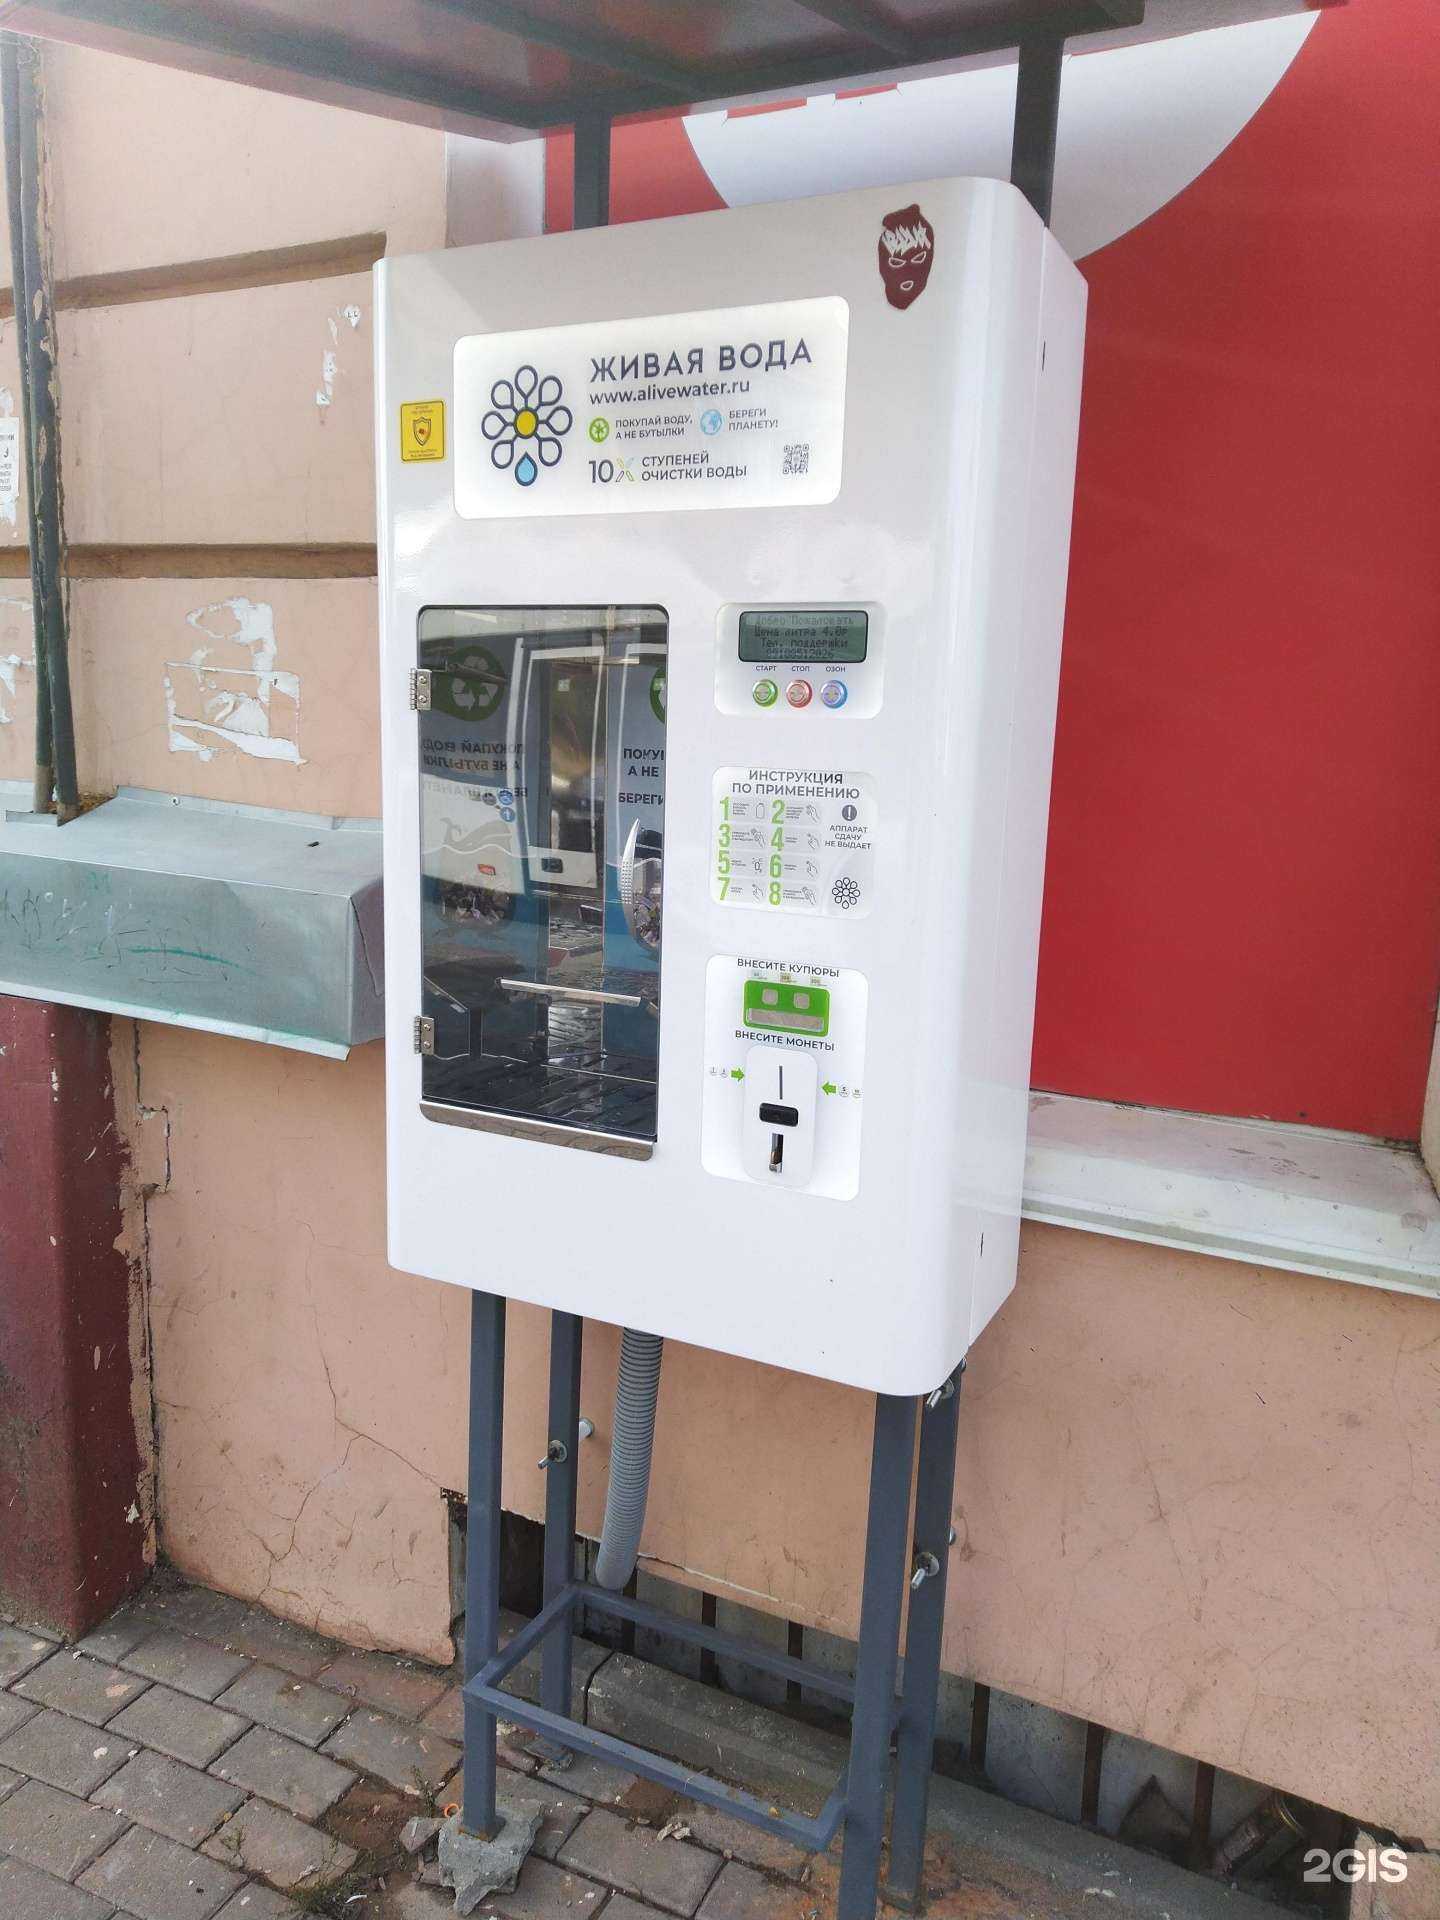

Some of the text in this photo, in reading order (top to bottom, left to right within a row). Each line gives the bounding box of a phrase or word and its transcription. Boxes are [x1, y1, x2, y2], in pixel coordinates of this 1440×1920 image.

[590, 337, 812, 383] ЖИВАЯ ВОДА
[589, 379, 750, 405] www.alivewater.ru
[615, 414, 694, 428] ПОКУПАЙ ВОДУ,
[729, 408, 767, 418] БЕРЕГИ
[615, 427, 685, 440] А НЕ БУТЫЛКИ
[729, 420, 779, 432] ПЛАНЕТУ!
[642, 451, 709, 467] СТУПЕНЕЙ
[588, 459, 614, 483] 10
[641, 466, 747, 482] ОЧИСТКИ ВОДЫ
[628, 766, 659, 777] А НЕ
[749, 770, 844, 785] ИНСТРУКЦИЯ
[732, 783, 860, 799] ПО ПРИМЕНЕНИЮ
[719, 797, 731, 820] 1
[771, 800, 786, 824] 2
[719, 824, 731, 847] 3
[829, 825, 868, 833] АППАРАТ
[834, 833, 862, 842] СДАЧУ
[771, 827, 784, 851] 4
[838, 842, 872, 850] ВЫДАЕТ
[718, 850, 731, 874] 5
[769, 854, 782, 878] 6
[717, 877, 731, 900] 7
[768, 882, 782, 905] 8
[737, 958, 840, 977] ВНЕСИТЕ КУПЮРЫ
[735, 1030, 834, 1051] ВНЕСИТЕ МОНЕТЫ
